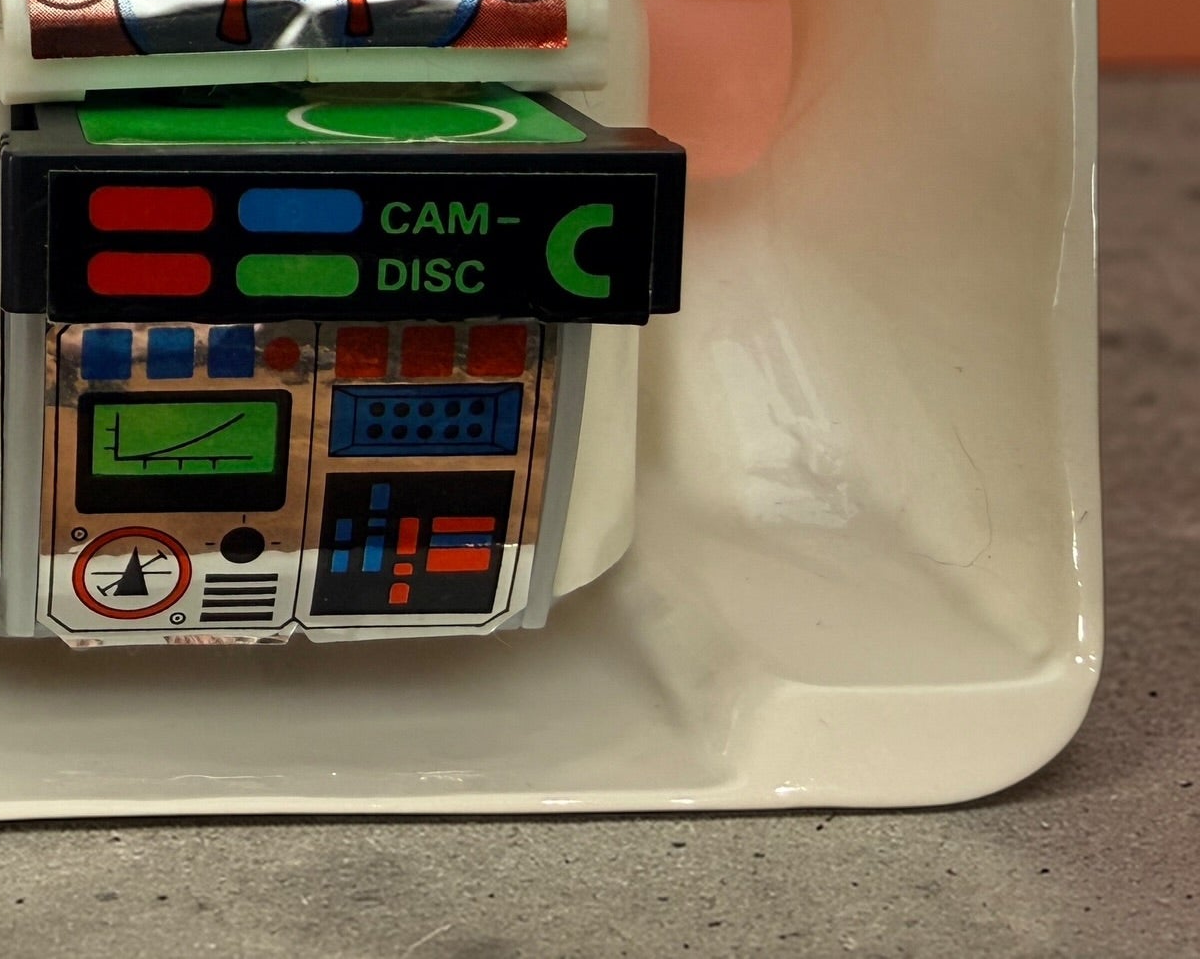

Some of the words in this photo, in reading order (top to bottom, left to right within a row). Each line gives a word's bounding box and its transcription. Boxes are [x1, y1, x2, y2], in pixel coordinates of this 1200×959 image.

[377, 258, 486, 294] DISC
[380, 201, 521, 235] CAM-
[545, 203, 615, 298] C
